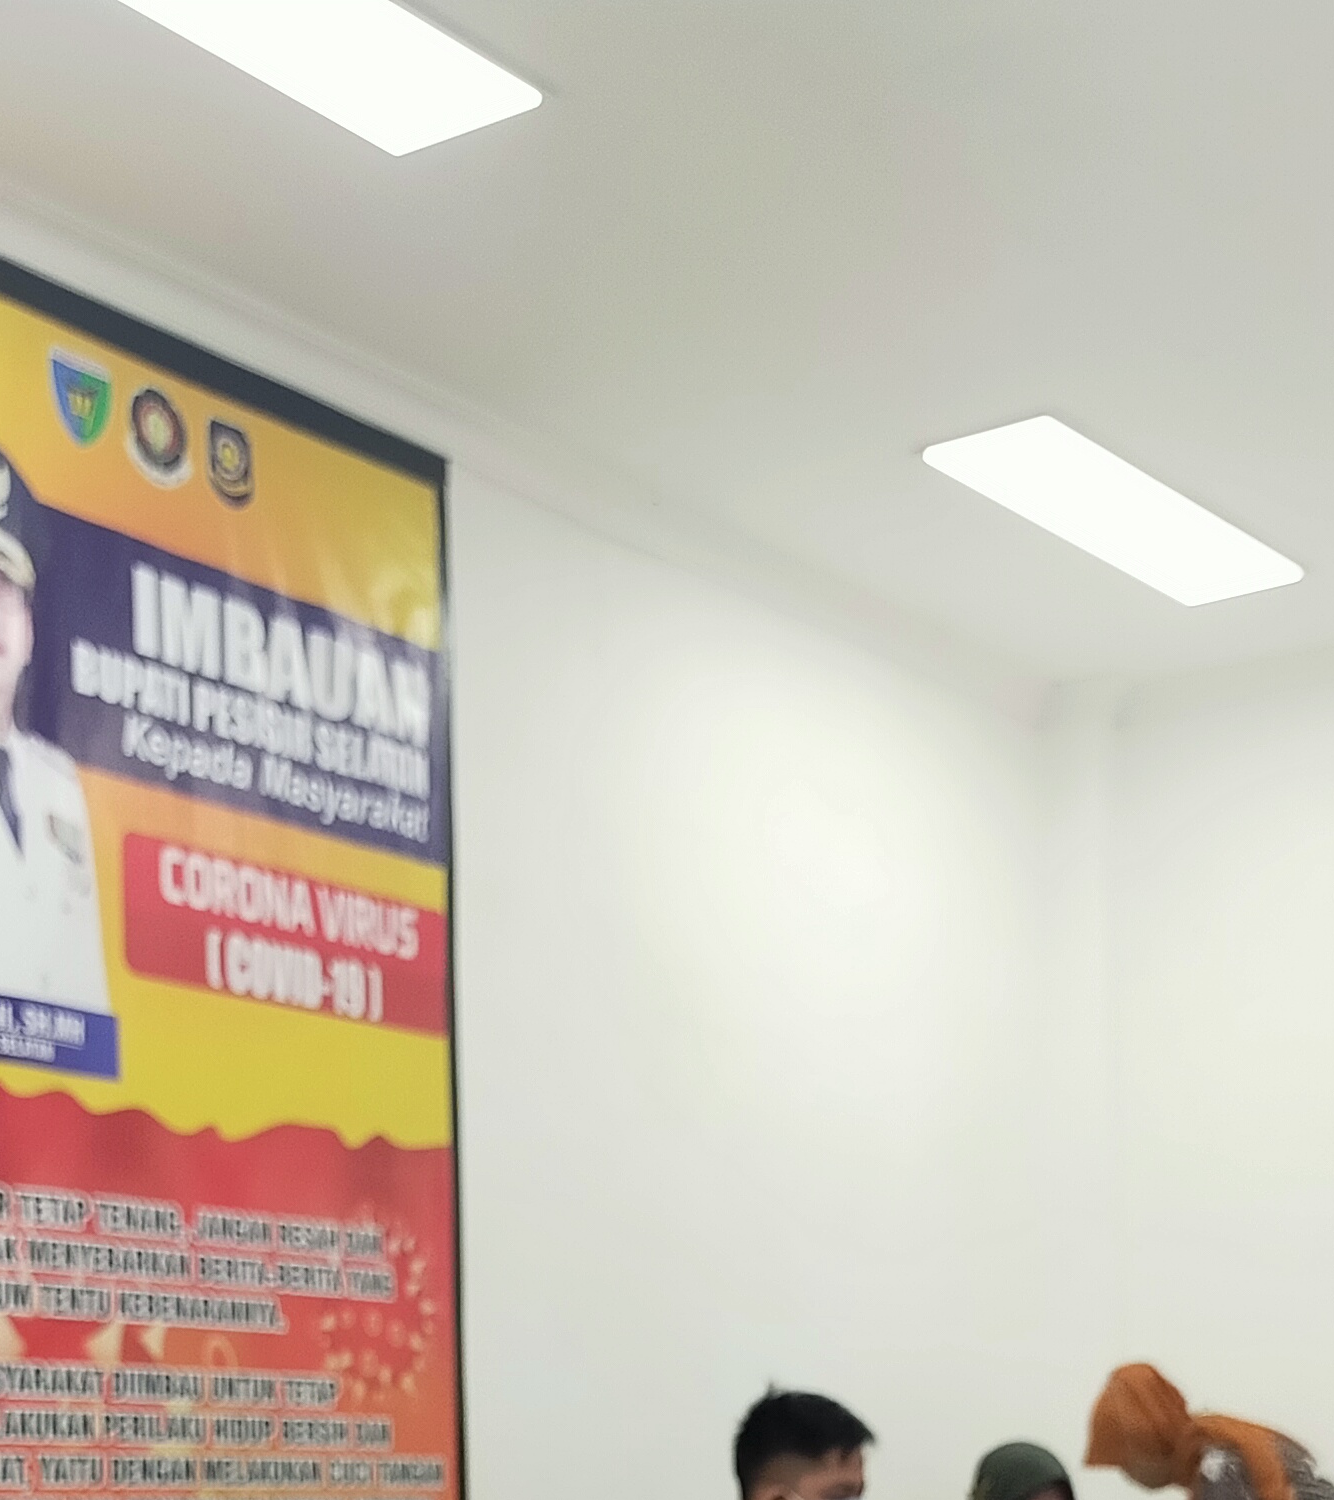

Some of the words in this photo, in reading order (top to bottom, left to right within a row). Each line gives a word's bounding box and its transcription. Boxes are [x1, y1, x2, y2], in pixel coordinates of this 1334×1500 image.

[70, 637, 192, 728] BUPATI
[130, 560, 430, 750] IMBAUAN
[121, 712, 255, 791] Kepada
[258, 749, 430, 844] Masyarakat
[158, 845, 317, 938] CORONA
[315, 885, 420, 961] VIRUS
[18, 1190, 88, 1229] TETAP
[36, 1282, 110, 1317] TENTU
[103, 1413, 203, 1441] PERILAKU
[112, 1455, 198, 1485] DENGAN
